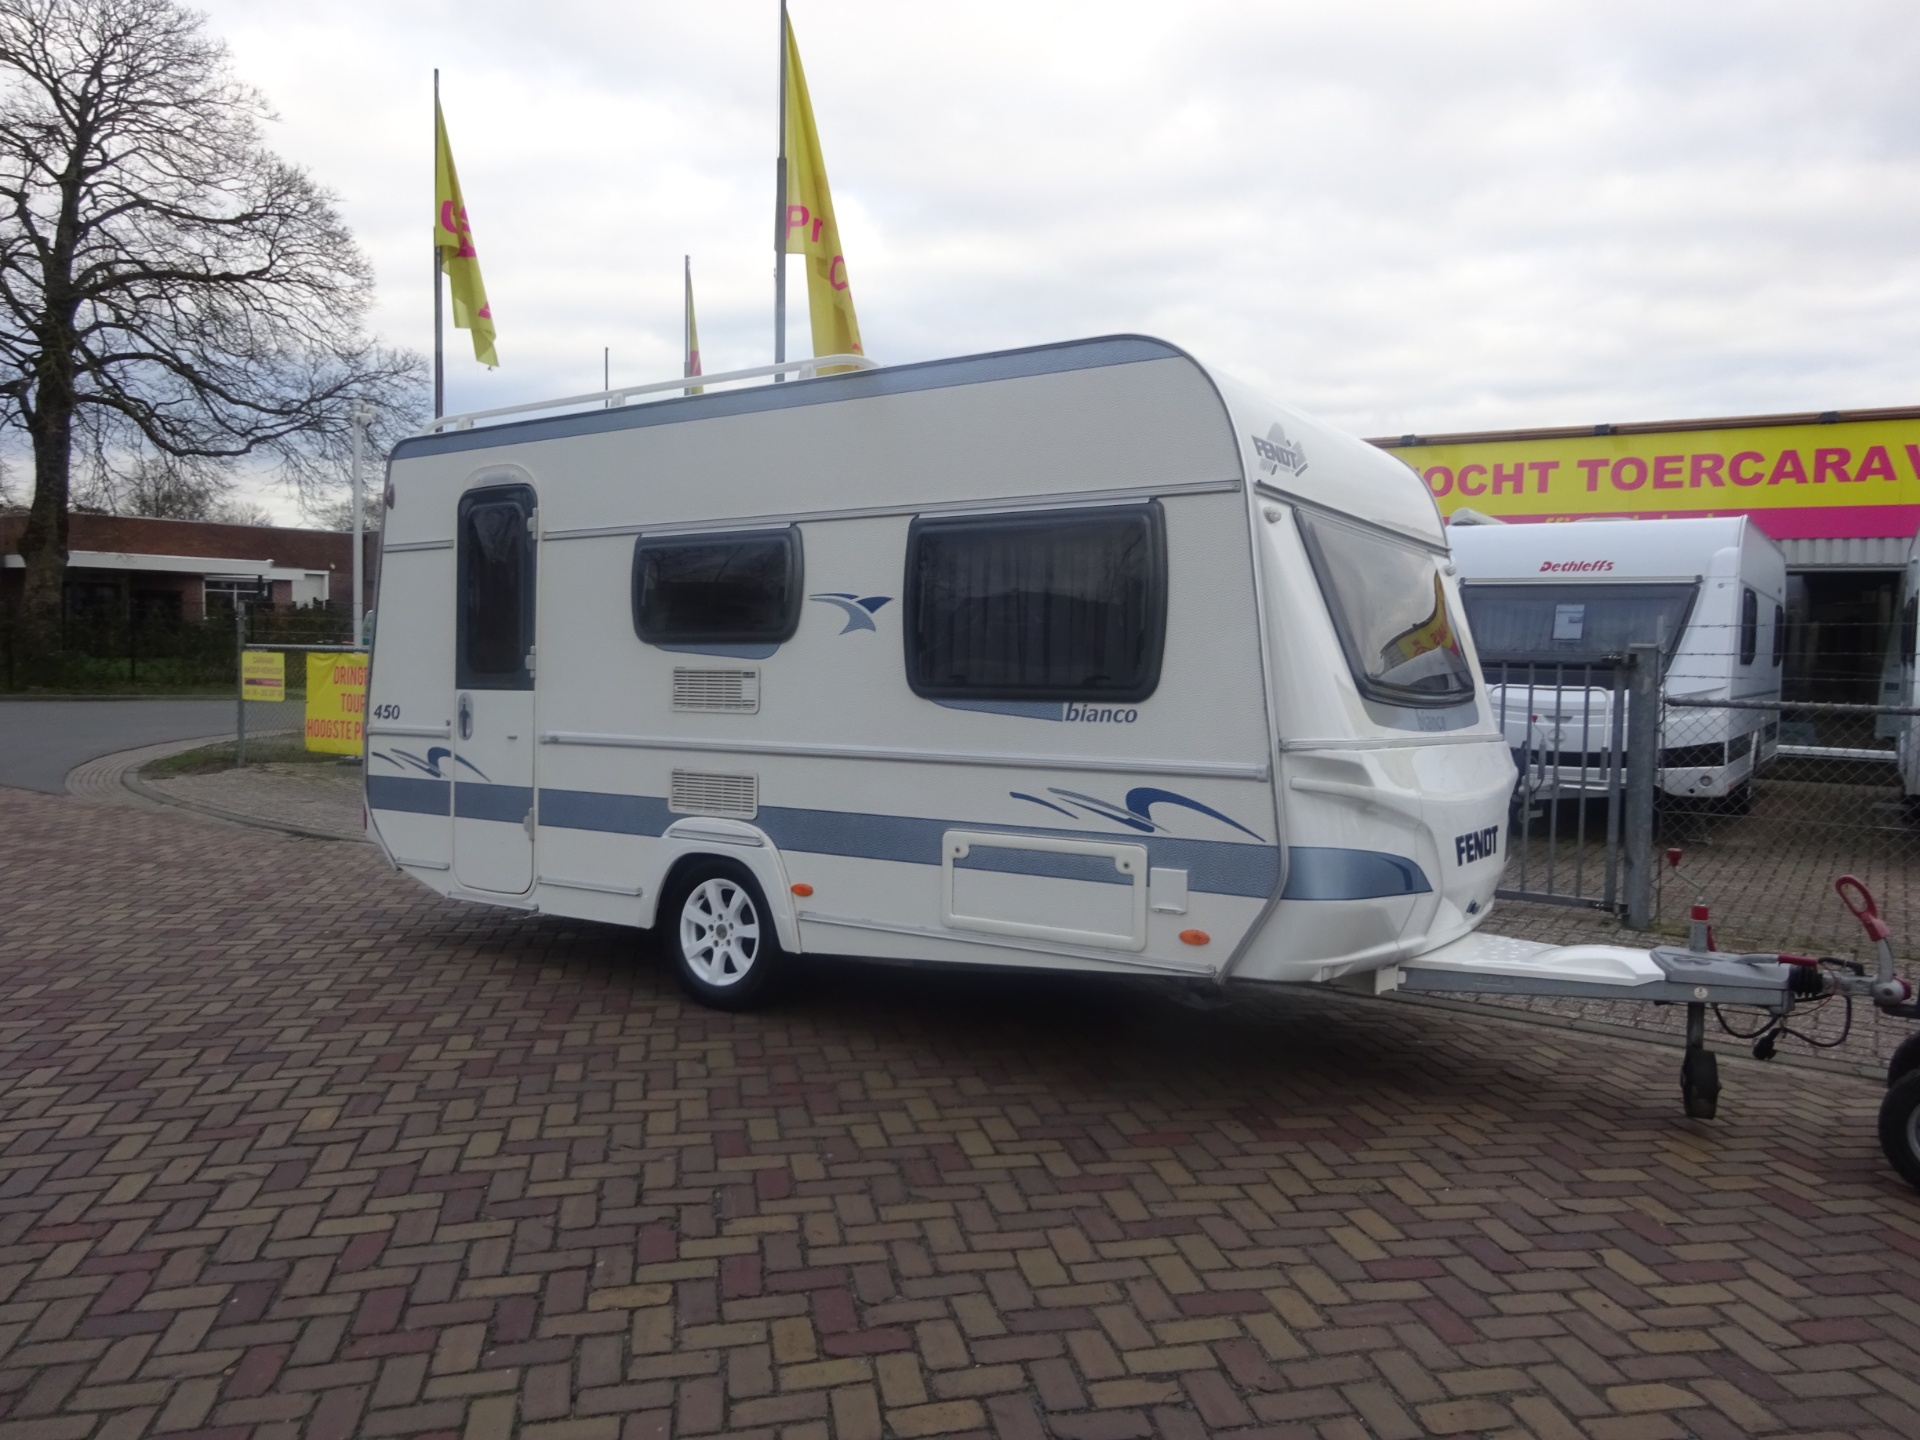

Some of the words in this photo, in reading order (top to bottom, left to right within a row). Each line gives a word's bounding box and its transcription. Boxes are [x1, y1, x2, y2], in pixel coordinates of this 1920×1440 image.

[1251, 434, 1297, 470] FENDT
[1416, 460, 1560, 498] OCHT
[1539, 560, 1614, 573] Dethleffs
[373, 704, 401, 720] 450
[1064, 701, 1138, 723] bianco
[307, 718, 352, 740] HOOGSTE
[1454, 824, 1499, 867] FENDT
